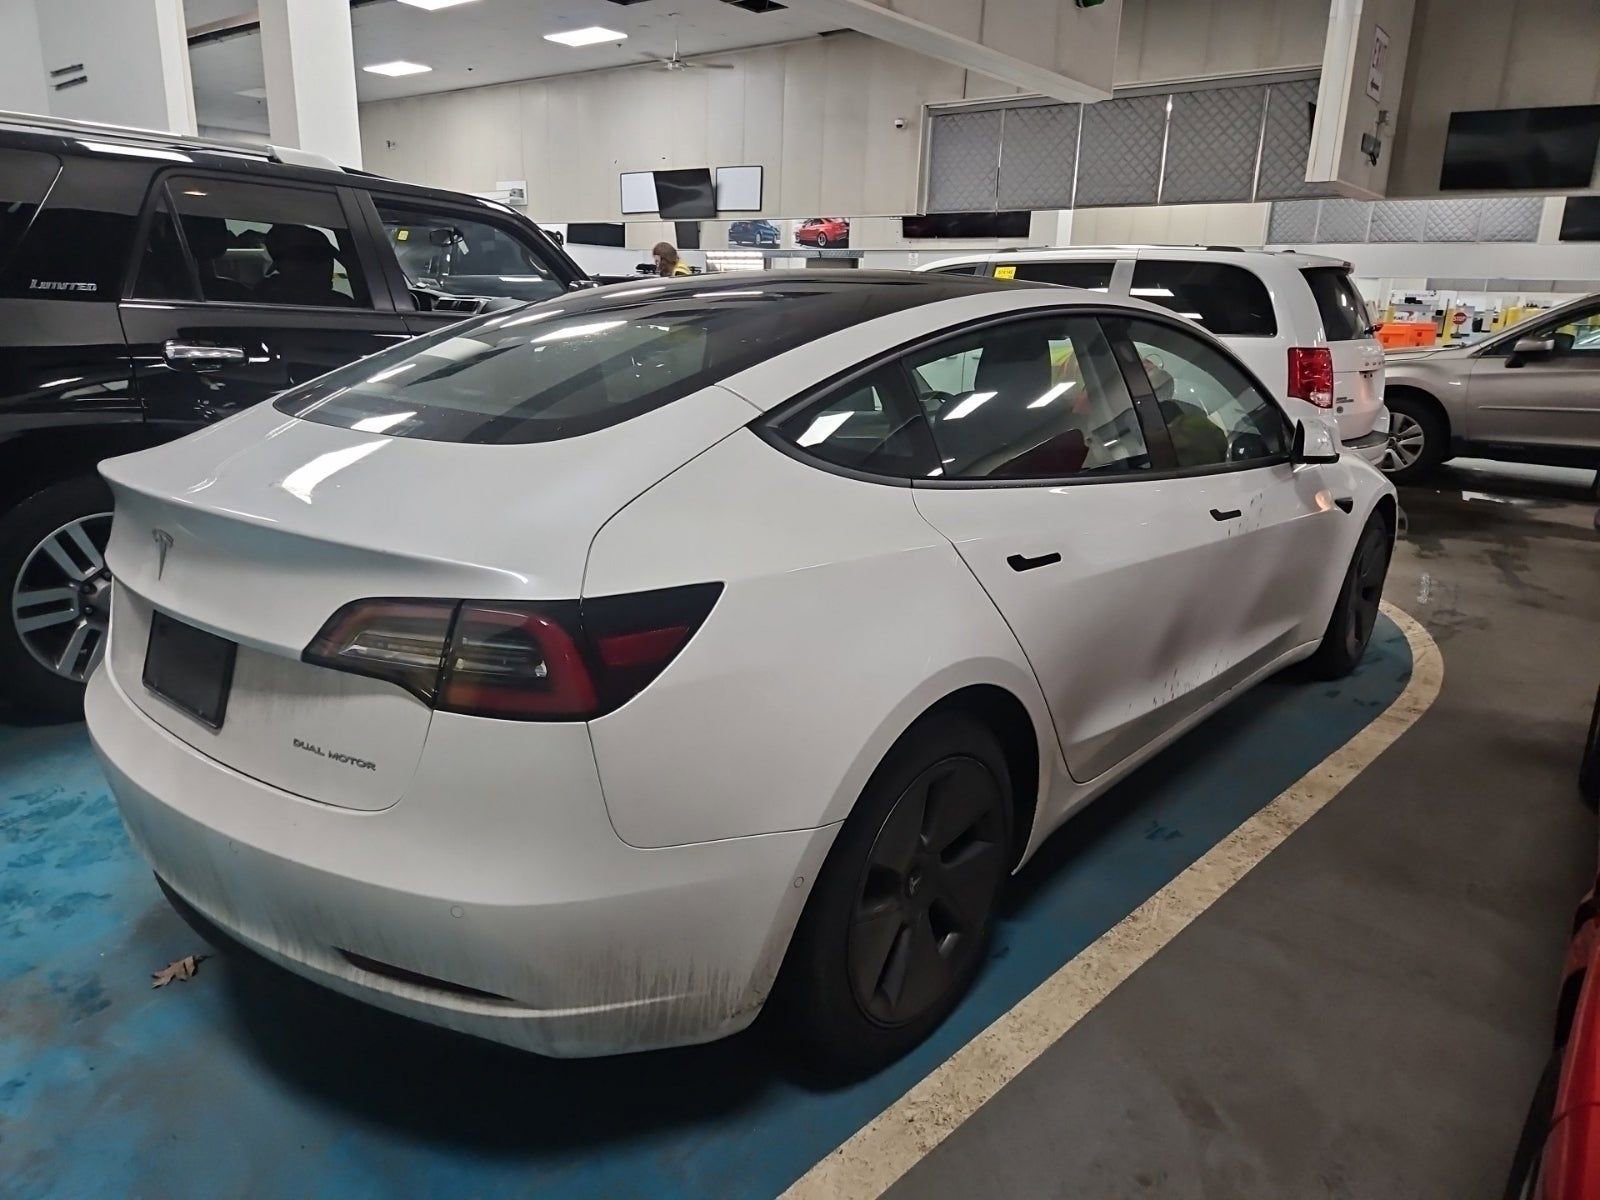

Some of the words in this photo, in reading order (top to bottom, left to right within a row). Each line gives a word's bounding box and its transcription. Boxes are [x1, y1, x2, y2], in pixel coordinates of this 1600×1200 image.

[29, 278, 98, 292] LIMITED
[292, 737, 326, 757] DUAL
[327, 749, 377, 772] MOTOR
